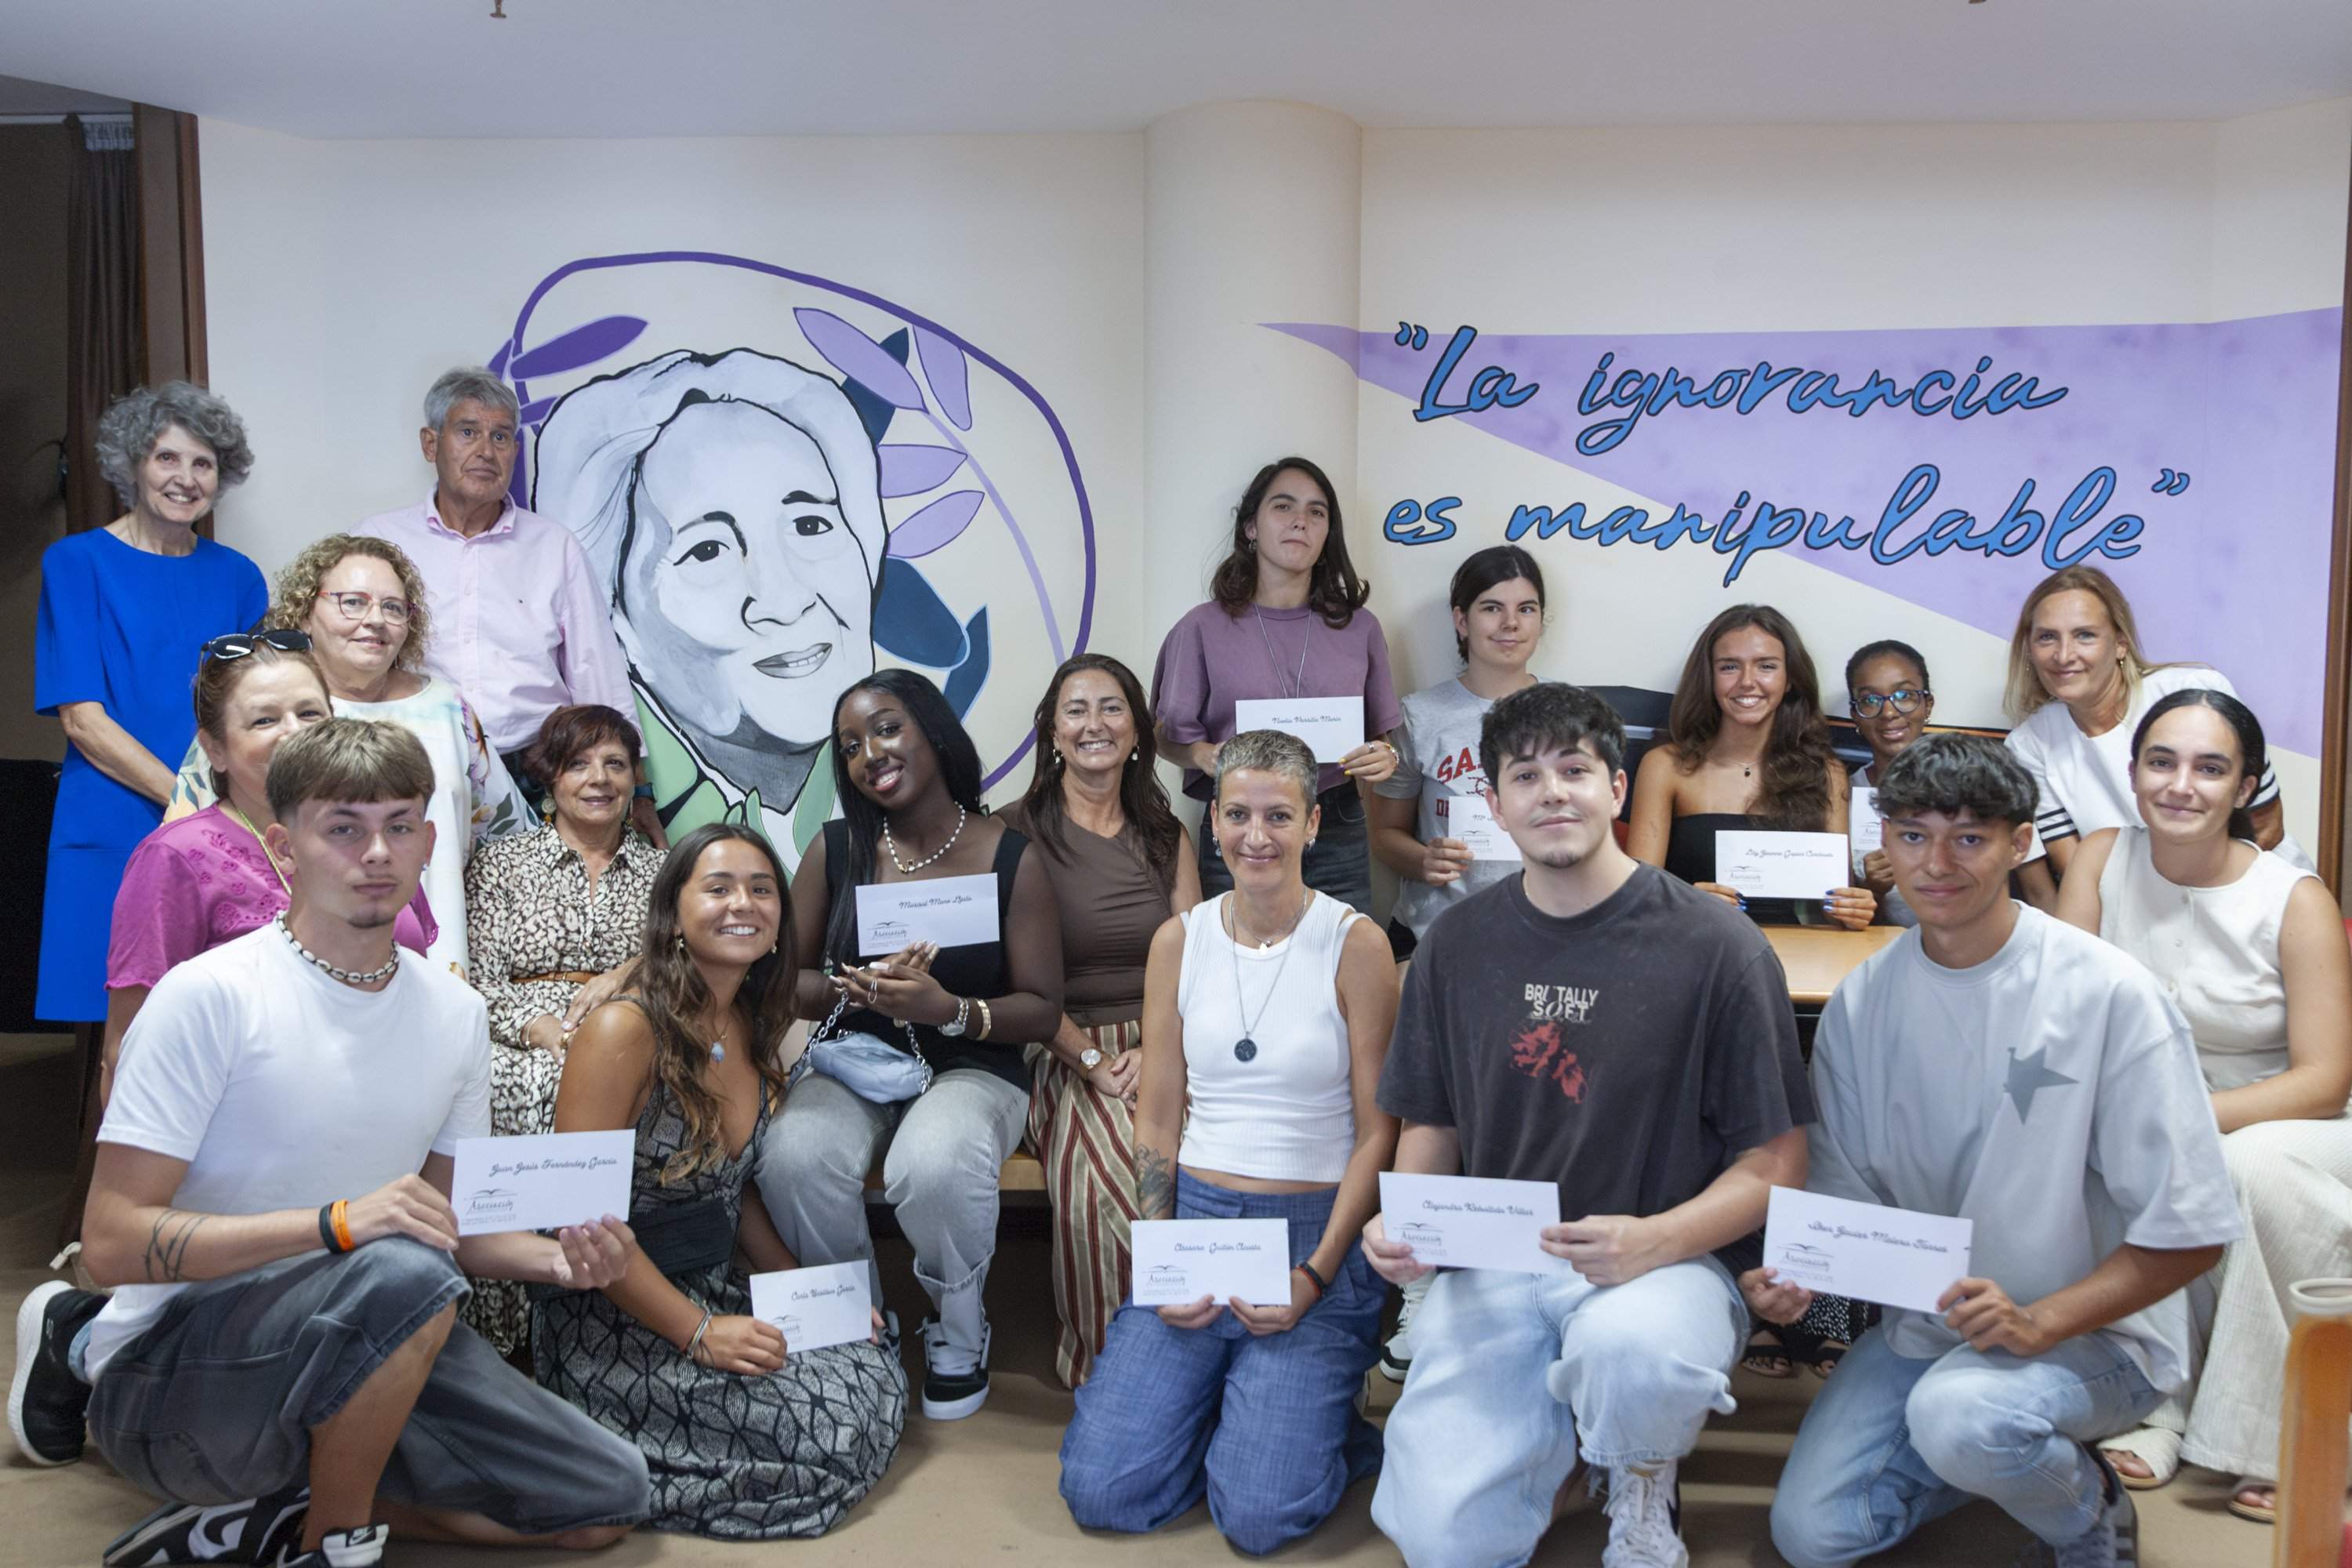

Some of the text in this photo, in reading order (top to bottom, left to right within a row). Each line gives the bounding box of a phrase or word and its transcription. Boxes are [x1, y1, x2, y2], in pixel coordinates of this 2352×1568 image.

[1576, 352, 2069, 456] ignorancia
[1383, 496, 1462, 544] es
[1437, 747, 1483, 784] SA
